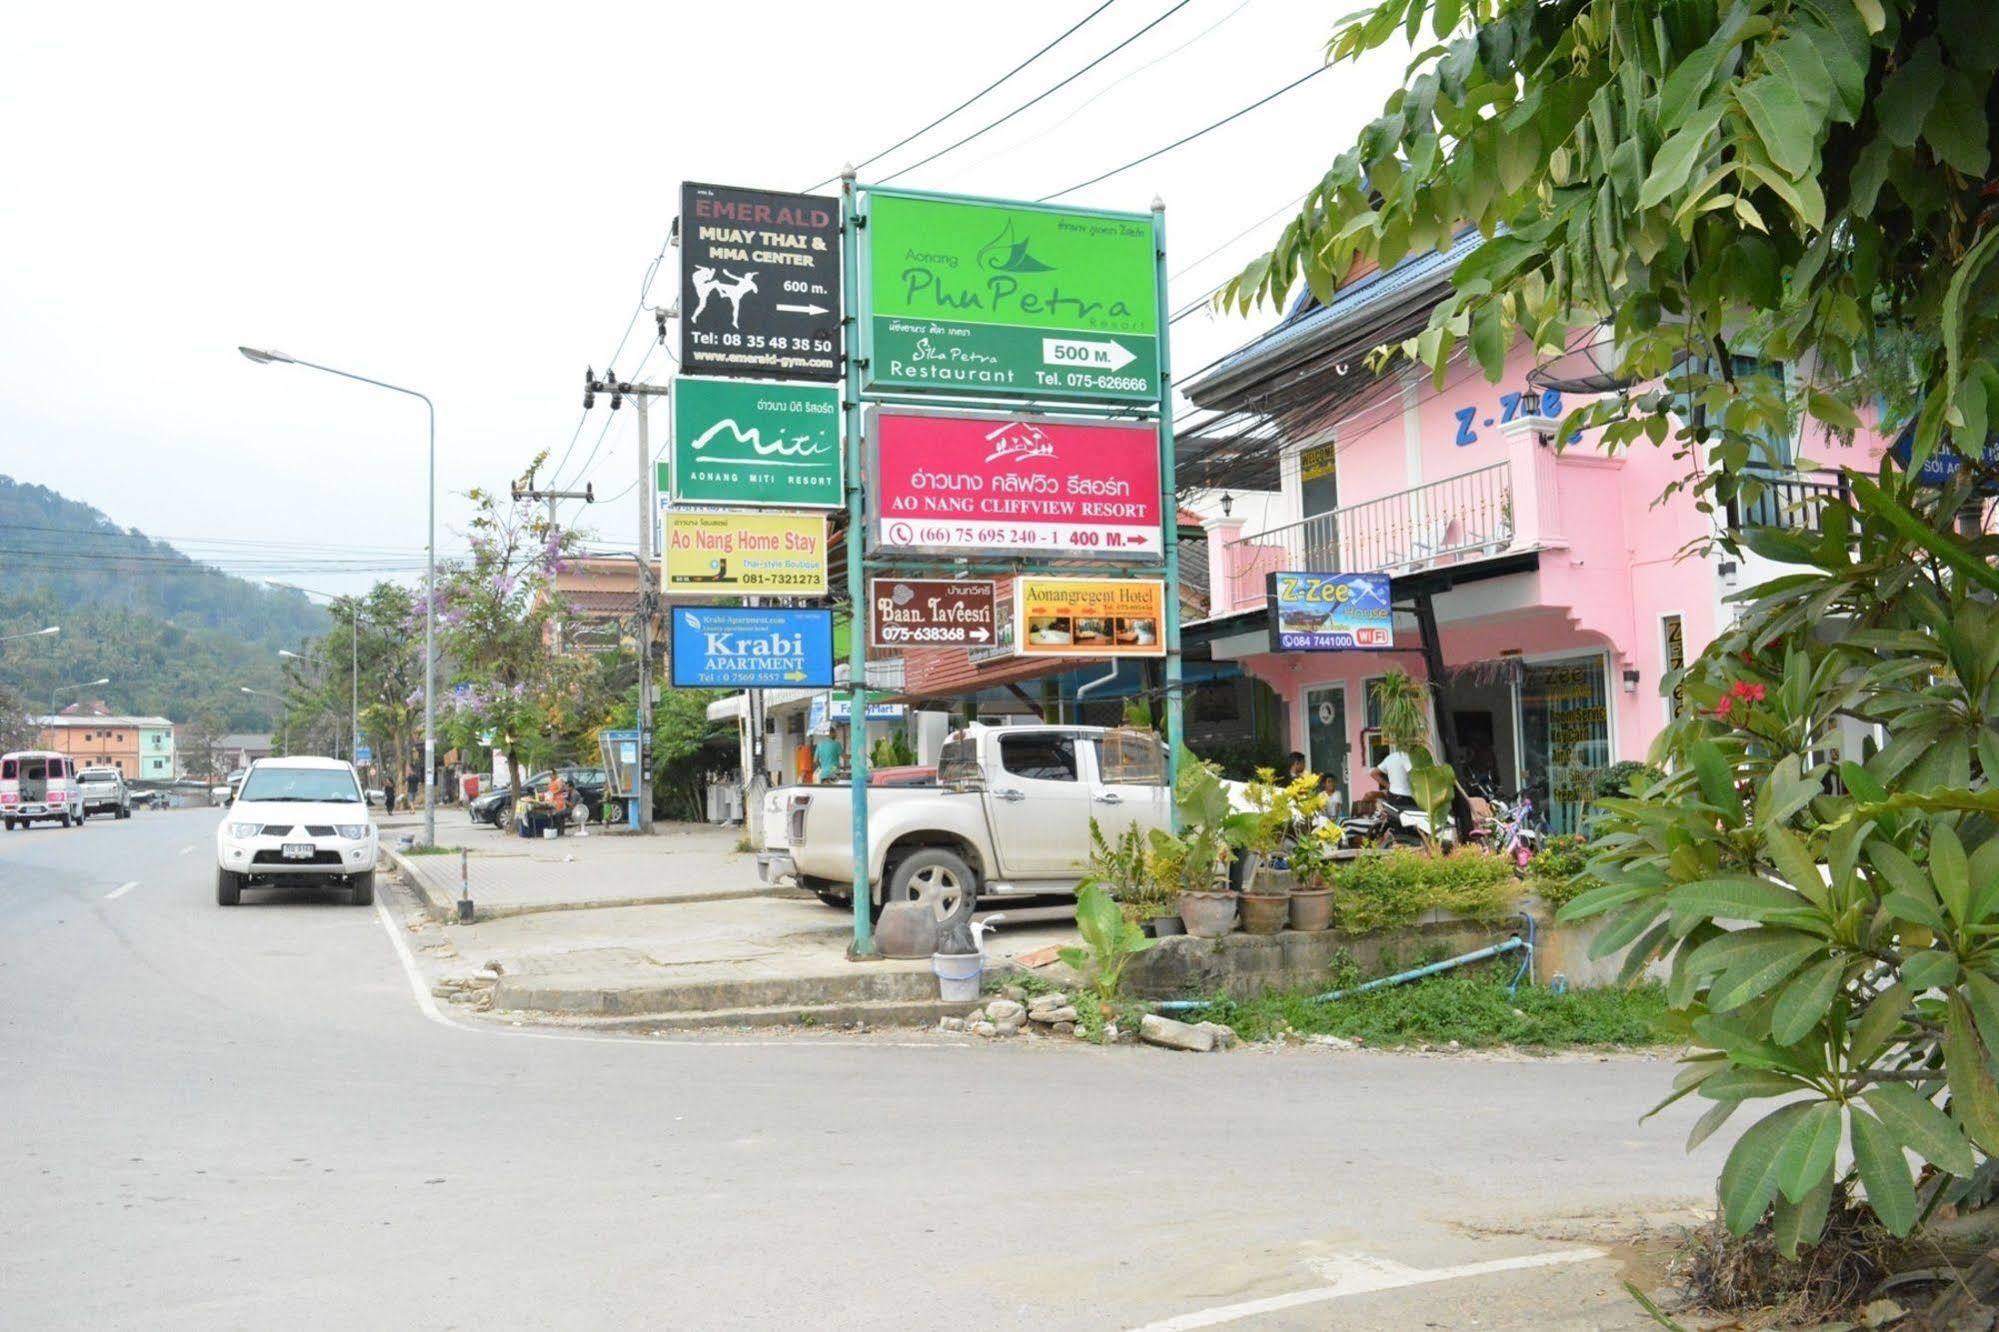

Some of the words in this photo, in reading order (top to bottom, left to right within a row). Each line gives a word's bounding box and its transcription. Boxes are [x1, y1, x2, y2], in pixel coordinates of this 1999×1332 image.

[695, 200, 830, 228] EMERALD
[699, 226, 757, 244] MUAY
[760, 232, 807, 249] THAI
[812, 237, 827, 251] &
[709, 247, 749, 261] MMA
[752, 251, 815, 267] CENTER
[905, 248, 959, 268] Aonang
[784, 281, 808, 293] 600
[811, 284, 828, 294] m.
[691, 332, 718, 345] Tel:
[723, 333, 741, 346] 08
[747, 335, 765, 348] 35
[769, 337, 787, 349] 48
[792, 338, 810, 351] 38
[814, 340, 832, 352] 50
[693, 351, 833, 368] www.emerald-gym.com
[950, 347, 998, 363] Petra
[1054, 345, 1089, 362] 500
[1094, 351, 1111, 363] M.
[891, 360, 1014, 384] Restaurant
[1036, 371, 1062, 387] Tel.
[1067, 373, 1148, 392] 075-626666
[691, 418, 833, 456] Miti
[691, 472, 738, 482] AONANG
[749, 475, 775, 483] MITI
[788, 476, 833, 485] RESORT
[911, 468, 983, 490] อ่าวนาง
[892, 495, 918, 510] AO
[925, 497, 974, 512] NANG
[981, 499, 1075, 516] CLIFFVIEW
[1081, 503, 1147, 518] RESORT
[672, 530, 691, 549] Ao
[696, 530, 733, 553] Nang
[738, 530, 779, 551] Home
[785, 532, 816, 554] Stay
[920, 528, 950, 544] (66)
[955, 529, 973, 543] 75
[978, 529, 1005, 543] 695
[1010, 530, 1036, 544] 240
[1069, 531, 1099, 546] 400
[1106, 533, 1127, 547] M.
[742, 574, 821, 585] 081-7321273
[1026, 587, 1114, 606] Aonangregent
[1119, 588, 1153, 603] Hotel
[1281, 577, 1350, 603] Z-Zee
[877, 598, 926, 622] Baan
[882, 627, 965, 640] 075-638368
[1294, 636, 1310, 647] 084
[1314, 636, 1352, 647] 7441000
[703, 632, 805, 656] Krabi
[705, 657, 806, 670] APARTMENT
[840, 703, 894, 714] FayMart
